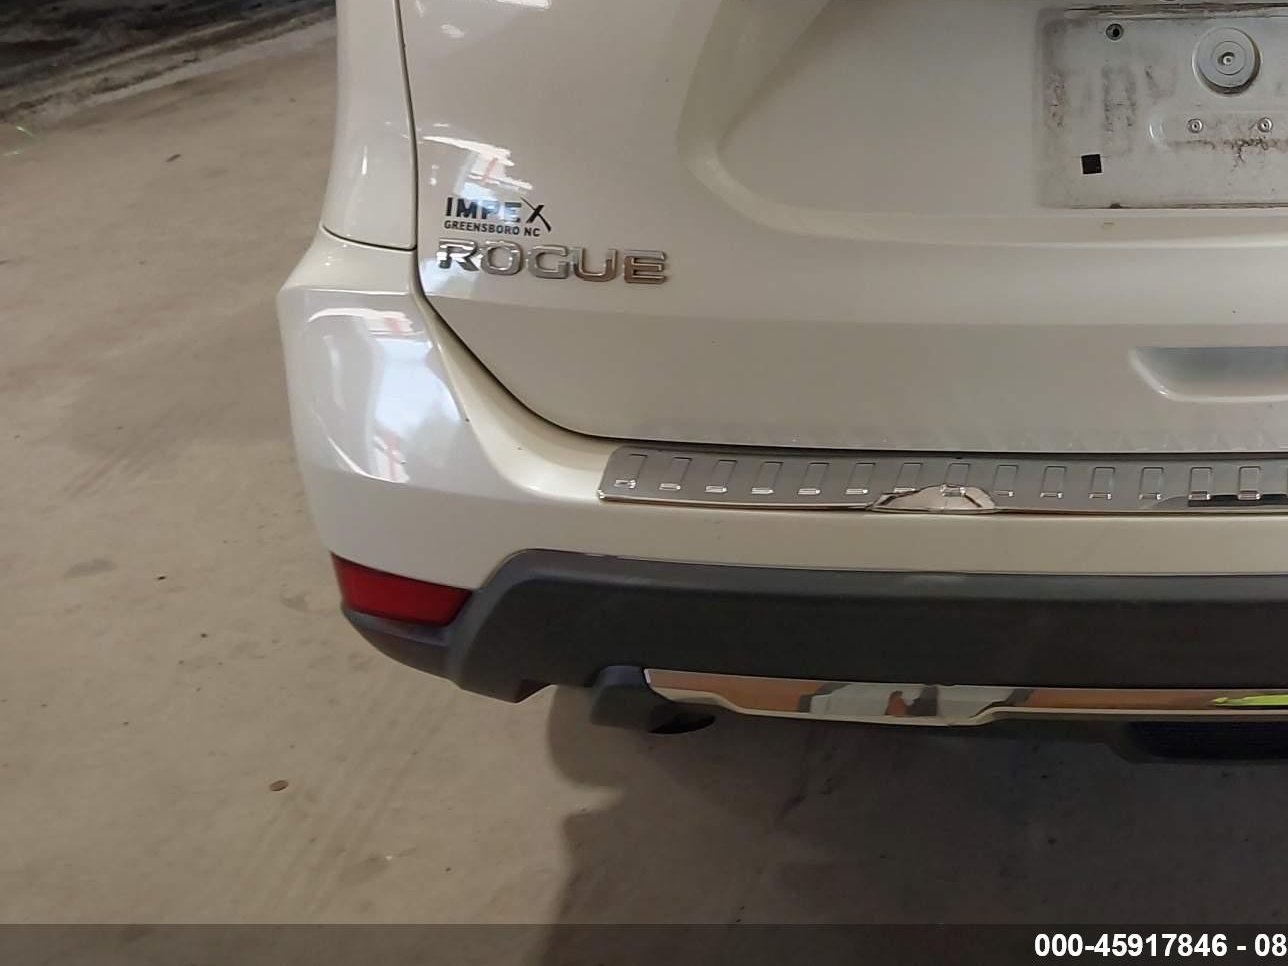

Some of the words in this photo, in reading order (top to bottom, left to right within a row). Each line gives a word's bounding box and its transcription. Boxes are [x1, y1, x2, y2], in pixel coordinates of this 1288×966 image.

[444, 220, 520, 235] GREENSBORO
[523, 227, 541, 237] NC
[445, 197, 552, 232] IMPEX
[436, 237, 668, 284] ROGUE
